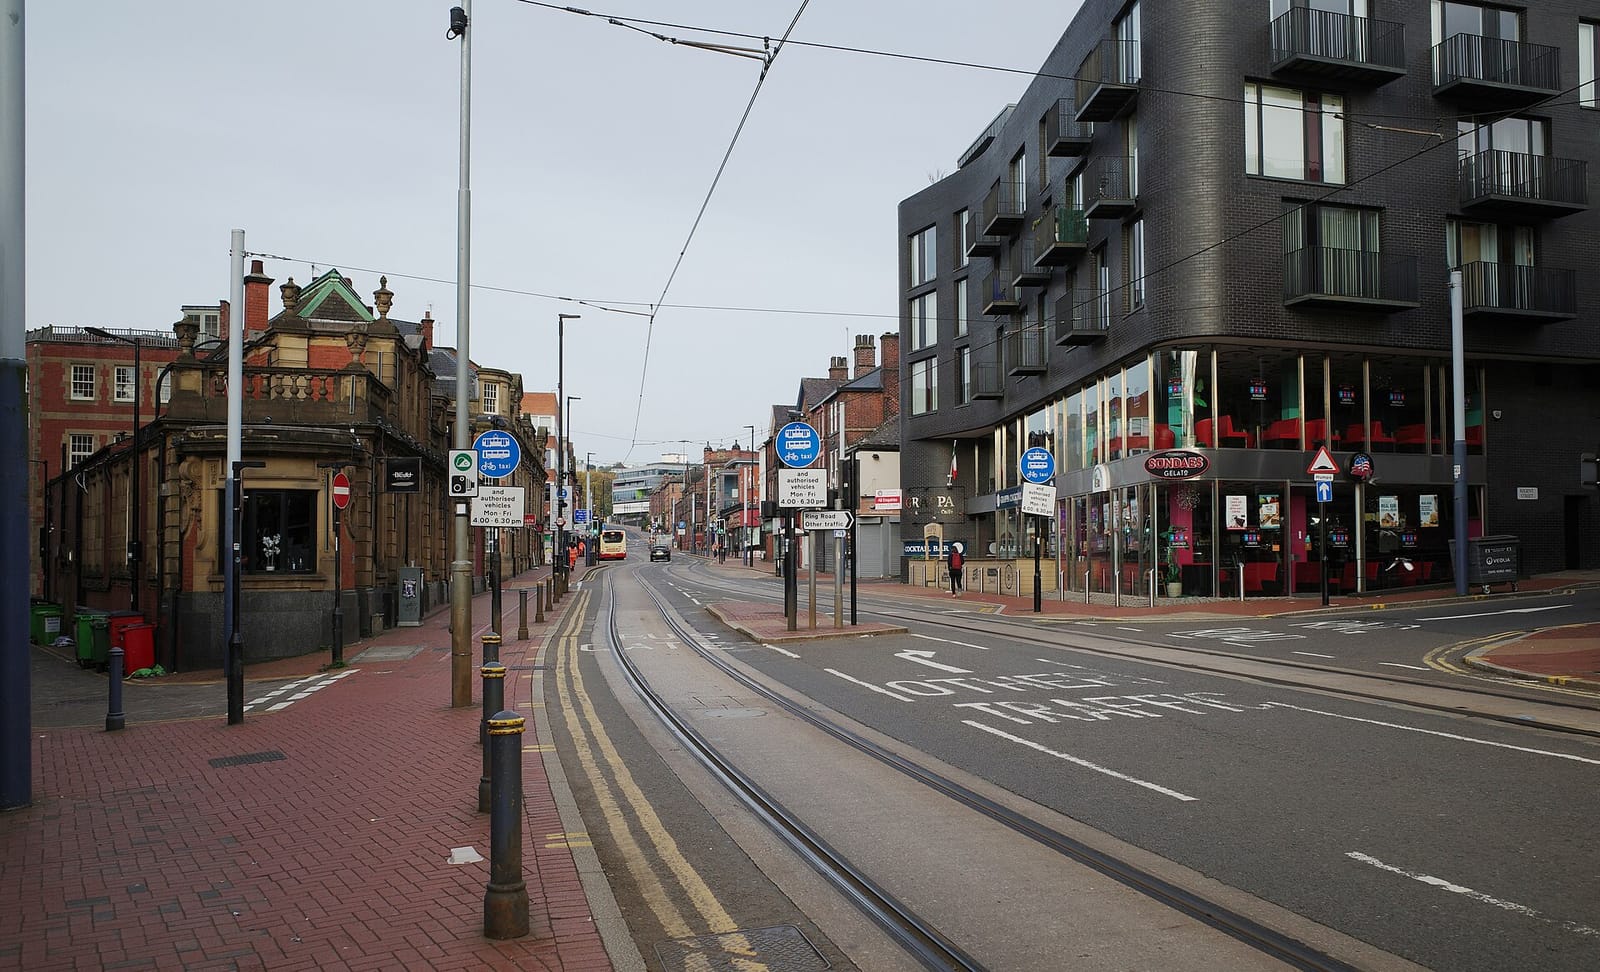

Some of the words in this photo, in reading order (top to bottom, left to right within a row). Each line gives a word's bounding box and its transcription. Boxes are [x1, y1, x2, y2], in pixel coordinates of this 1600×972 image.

[1148, 456, 1204, 469] SUNDAES
[1163, 469, 1189, 477] GELATO
[953, 692, 1272, 724] TRAFFIC
